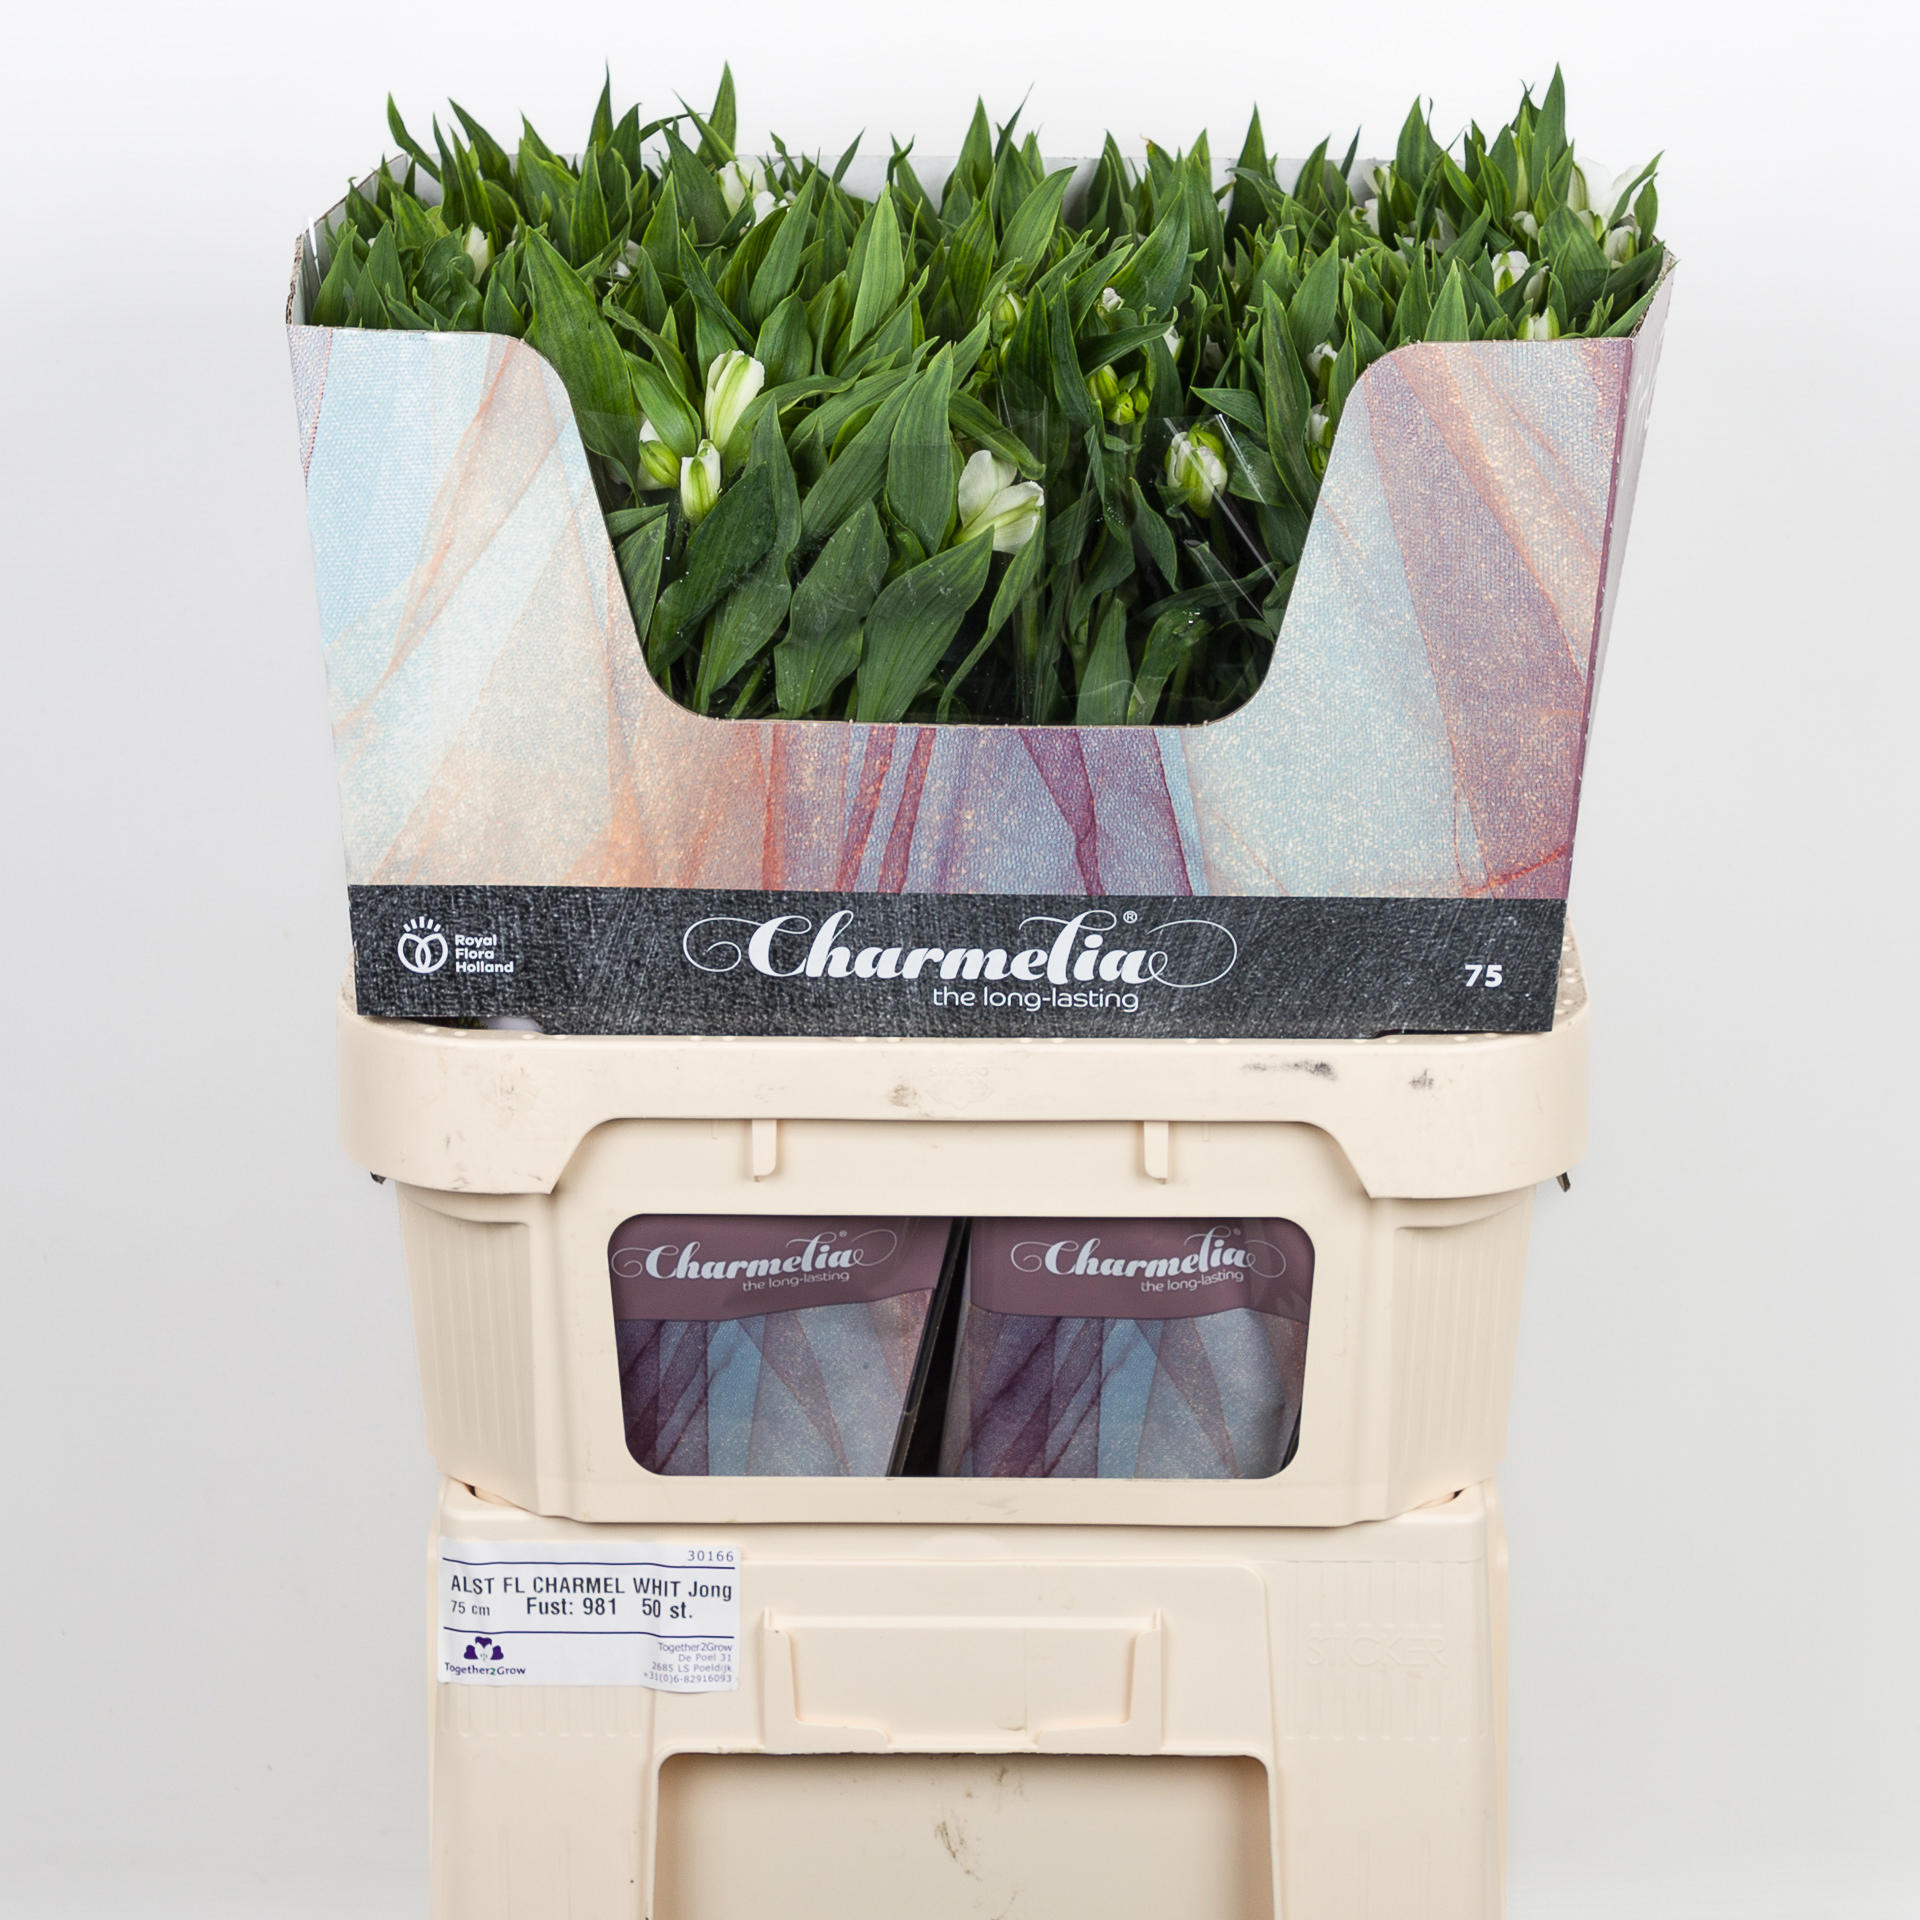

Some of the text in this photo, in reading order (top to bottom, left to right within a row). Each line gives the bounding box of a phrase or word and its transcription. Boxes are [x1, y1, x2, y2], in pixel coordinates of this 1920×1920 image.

[455, 934, 497, 948] Royal
[455, 947, 495, 960] Flora
[455, 960, 514, 973] Holland
[1464, 964, 1503, 988] 75
[933, 986, 1139, 1012] the long-lasting
[742, 1271, 850, 1292] the long-lasting
[1141, 1269, 1244, 1292] the long-lasting
[687, 1550, 734, 1562] 30166
[451, 1575, 732, 1602] ALST FL CHARMEL WHIT Jong
[451, 1600, 490, 1616] 75 cm
[526, 1597, 692, 1619] Fust: 981 50 st.
[658, 1642, 732, 1654] Together2Grow
[678, 1653, 732, 1662] De Poel 31
[445, 1662, 526, 1676] Together2Grow
[652, 1661, 731, 1674] 2685 LS Poeldijk
